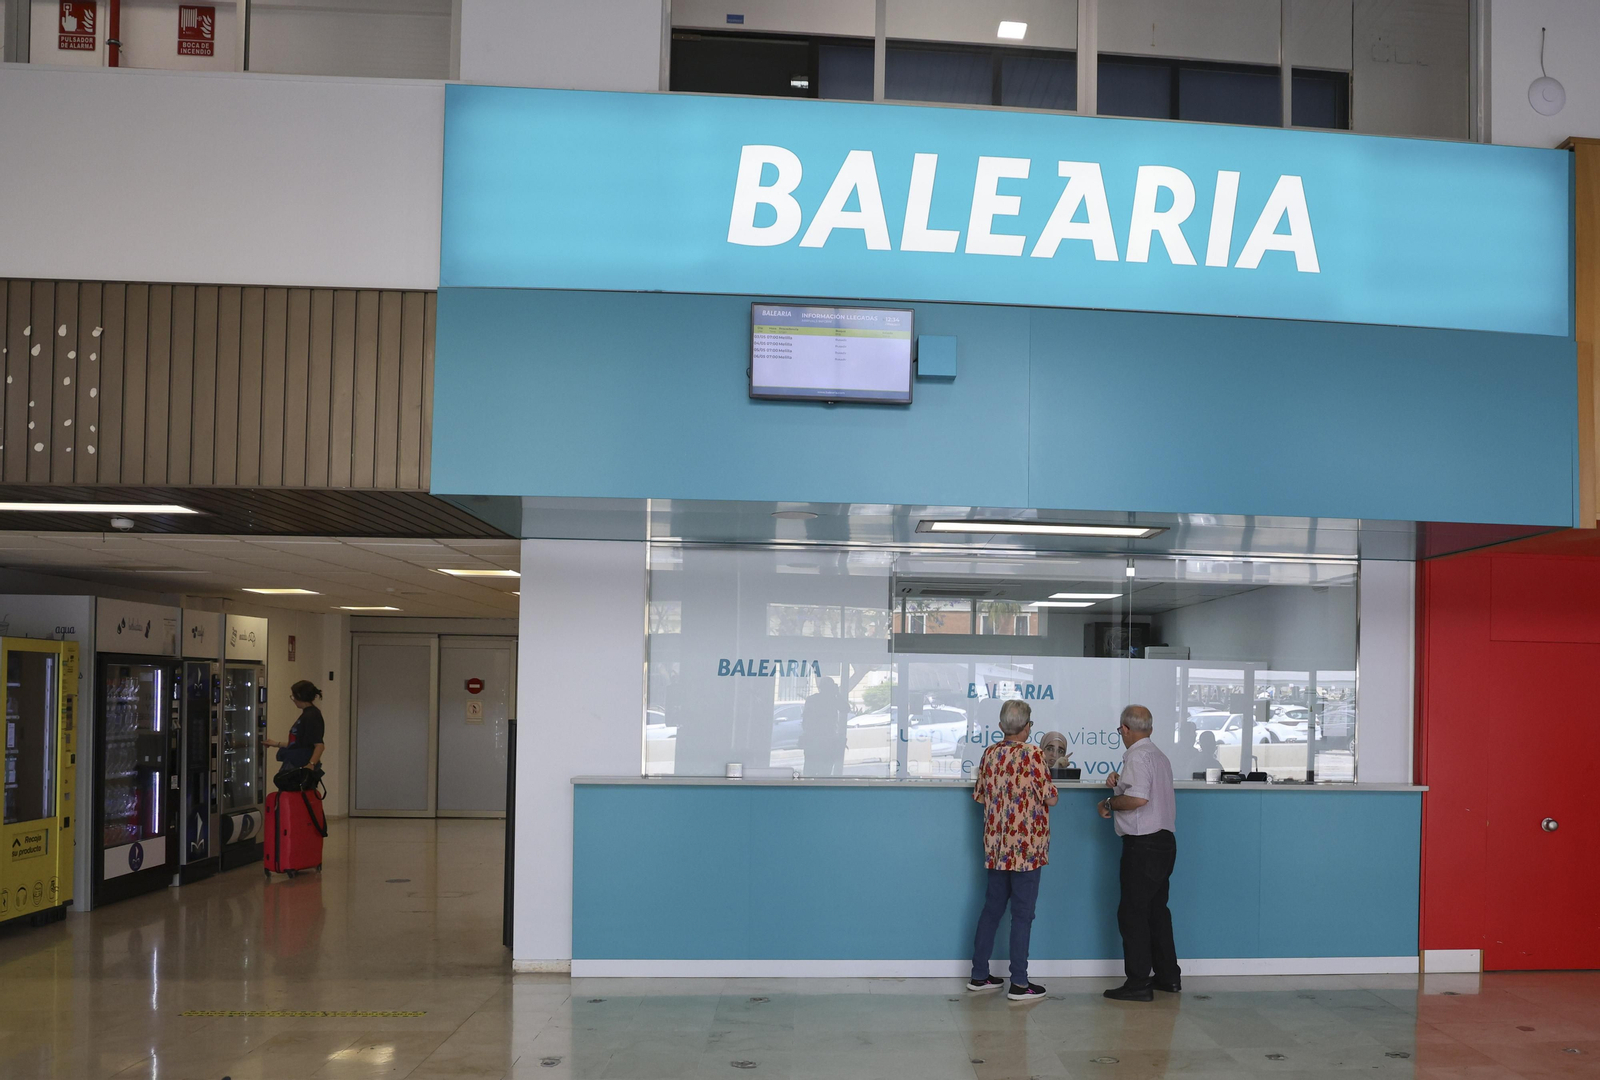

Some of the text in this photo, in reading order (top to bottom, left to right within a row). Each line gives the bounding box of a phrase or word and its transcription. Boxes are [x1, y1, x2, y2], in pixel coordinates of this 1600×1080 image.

[60, 36, 94, 44] PULSADOR
[726, 144, 1321, 273] BALEARIA
[801, 312, 845, 320] INFORMACIÓN
[717, 658, 822, 678] BALEARIA
[967, 682, 1055, 700] BLARIA
[888, 728, 944, 743] uen
[950, 725, 1004, 748] viaje
[1068, 727, 1121, 750] viatg
[24, 834, 42, 844] Recoja
[18, 845, 42, 858] producto
